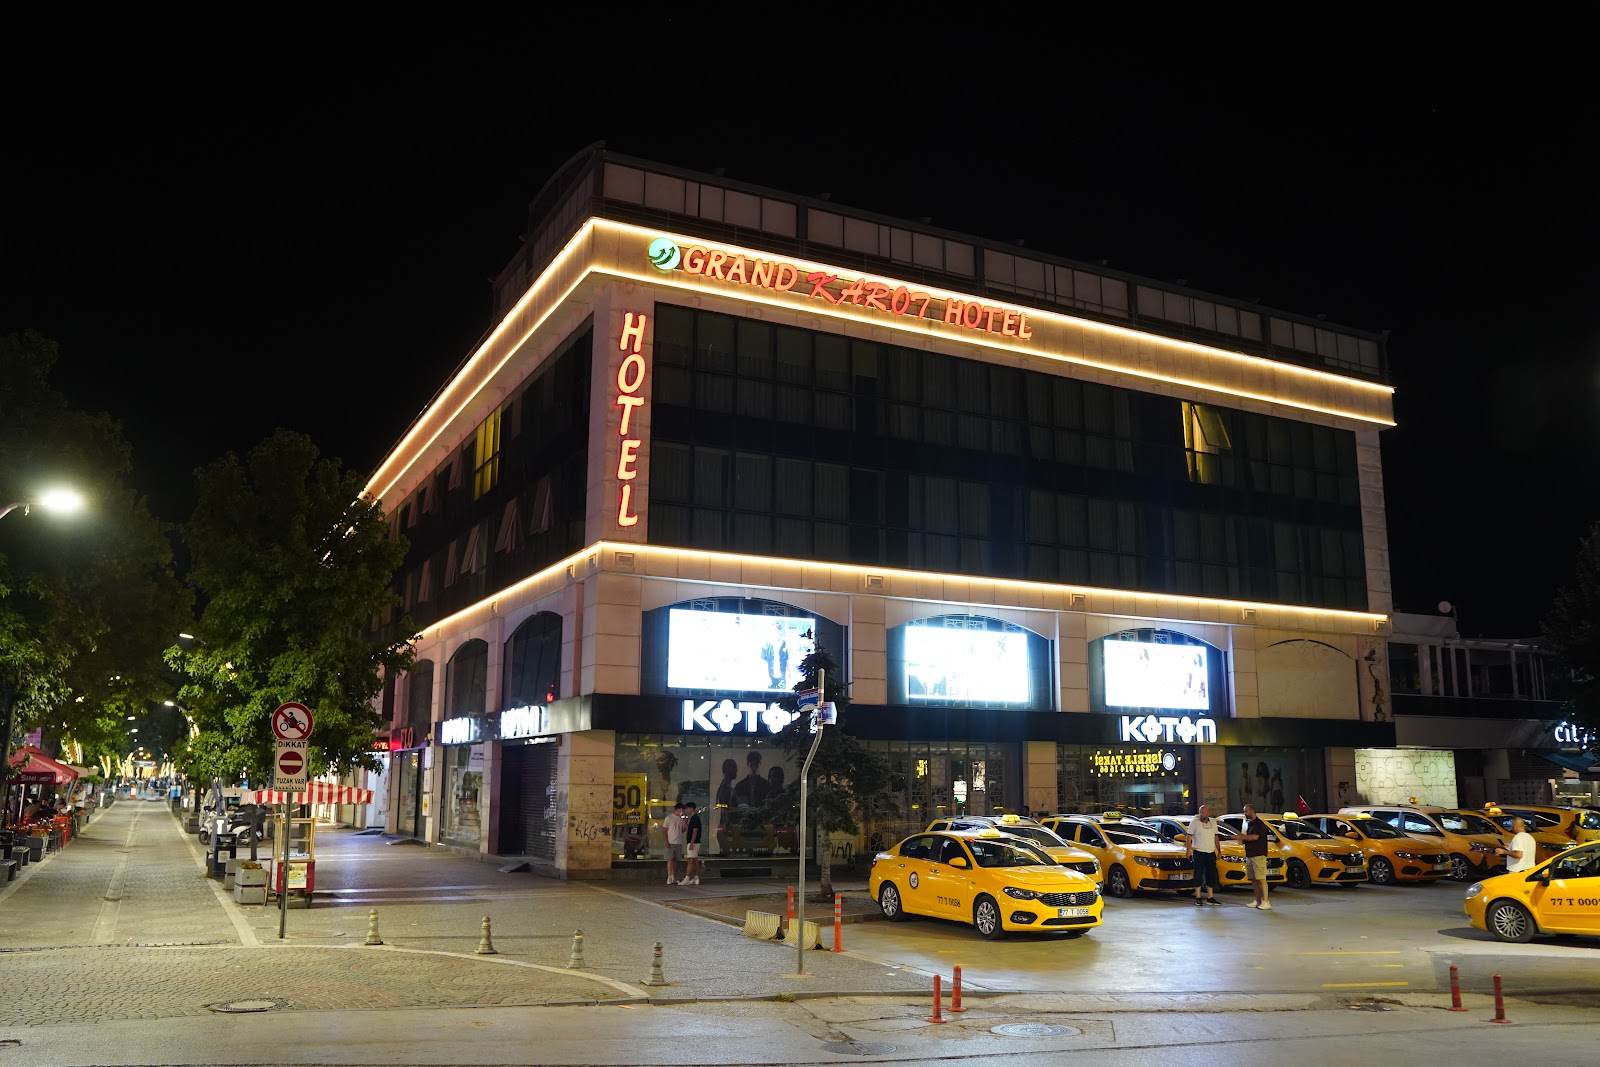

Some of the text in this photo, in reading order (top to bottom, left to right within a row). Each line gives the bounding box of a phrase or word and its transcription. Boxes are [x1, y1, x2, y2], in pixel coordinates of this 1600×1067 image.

[682, 245, 798, 293] GRAND
[944, 297, 1034, 341] HOTEL
[616, 311, 647, 528] HOTEL
[1121, 715, 1217, 744] KOTON
[1551, 898, 1563, 906] 77
[1566, 898, 1575, 906] T
